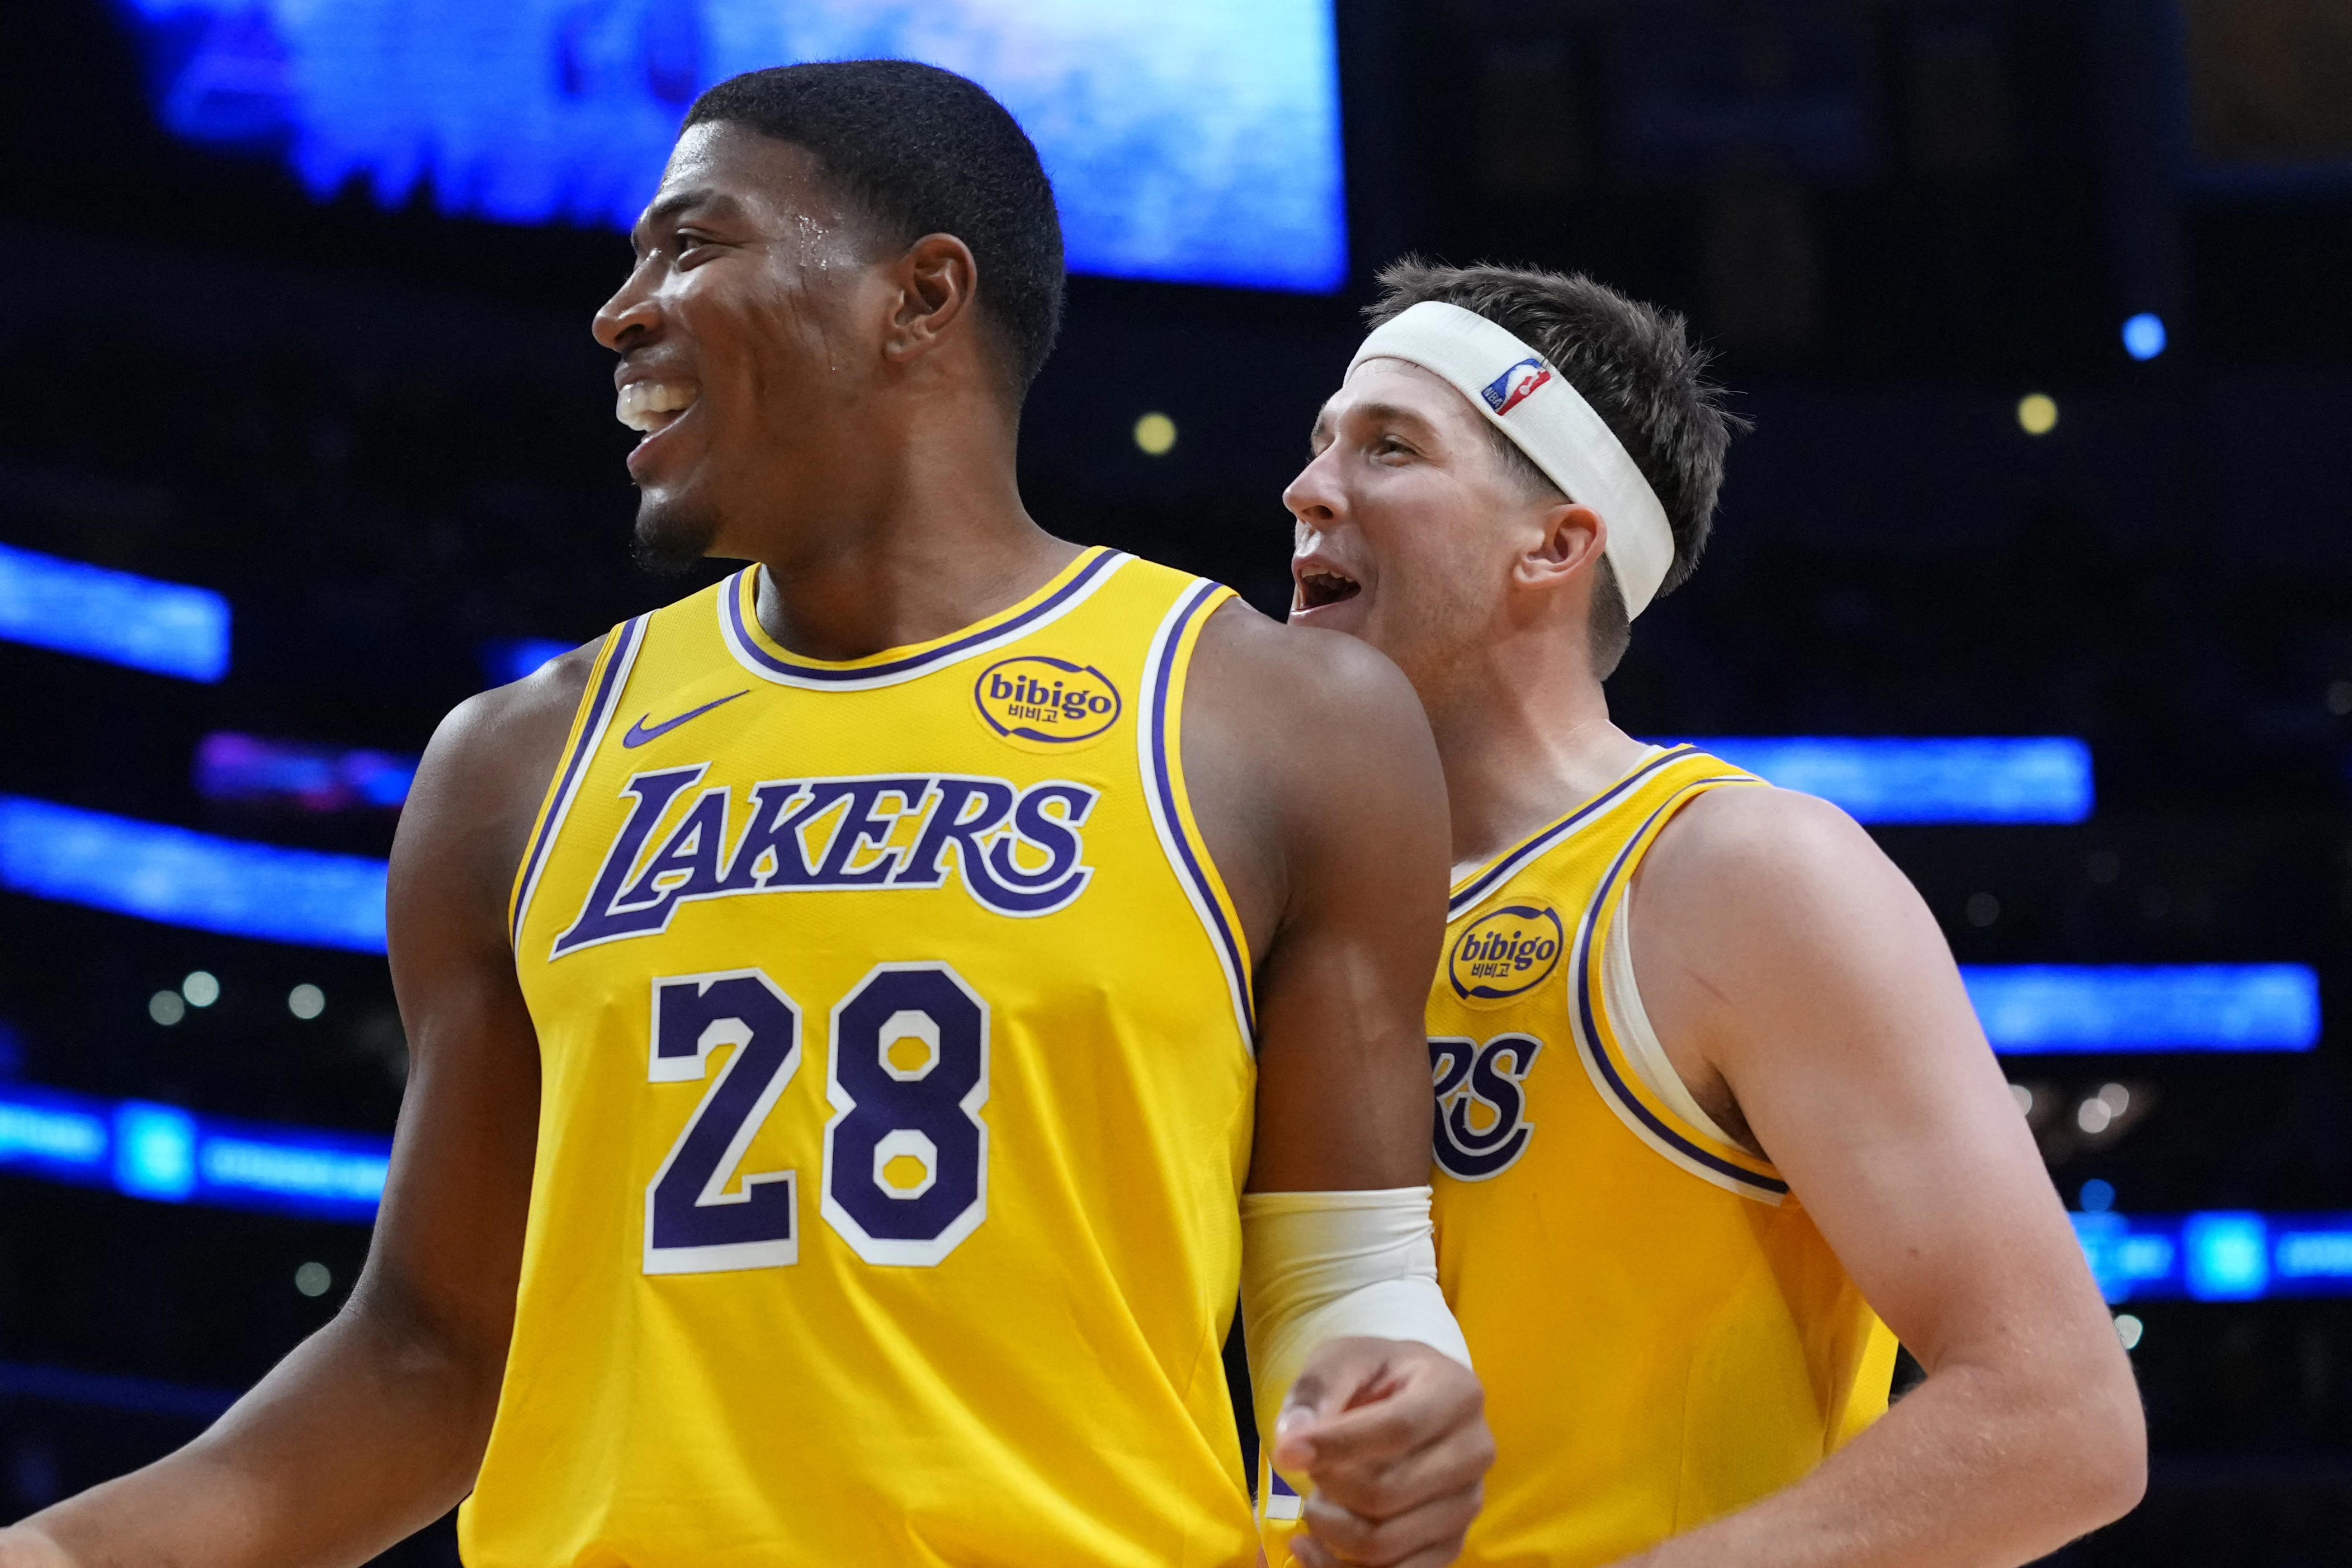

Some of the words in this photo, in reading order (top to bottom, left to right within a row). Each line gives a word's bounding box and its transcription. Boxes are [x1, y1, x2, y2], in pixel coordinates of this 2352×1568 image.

[1483, 387, 1504, 408] NBA
[990, 673, 1112, 719] bibigo
[1008, 704, 1058, 723] 비비고
[548, 761, 1101, 962] LAKERS
[1461, 931, 1555, 970] bibigo
[1470, 962, 1510, 978] 비비고
[643, 960, 990, 1276] 28
